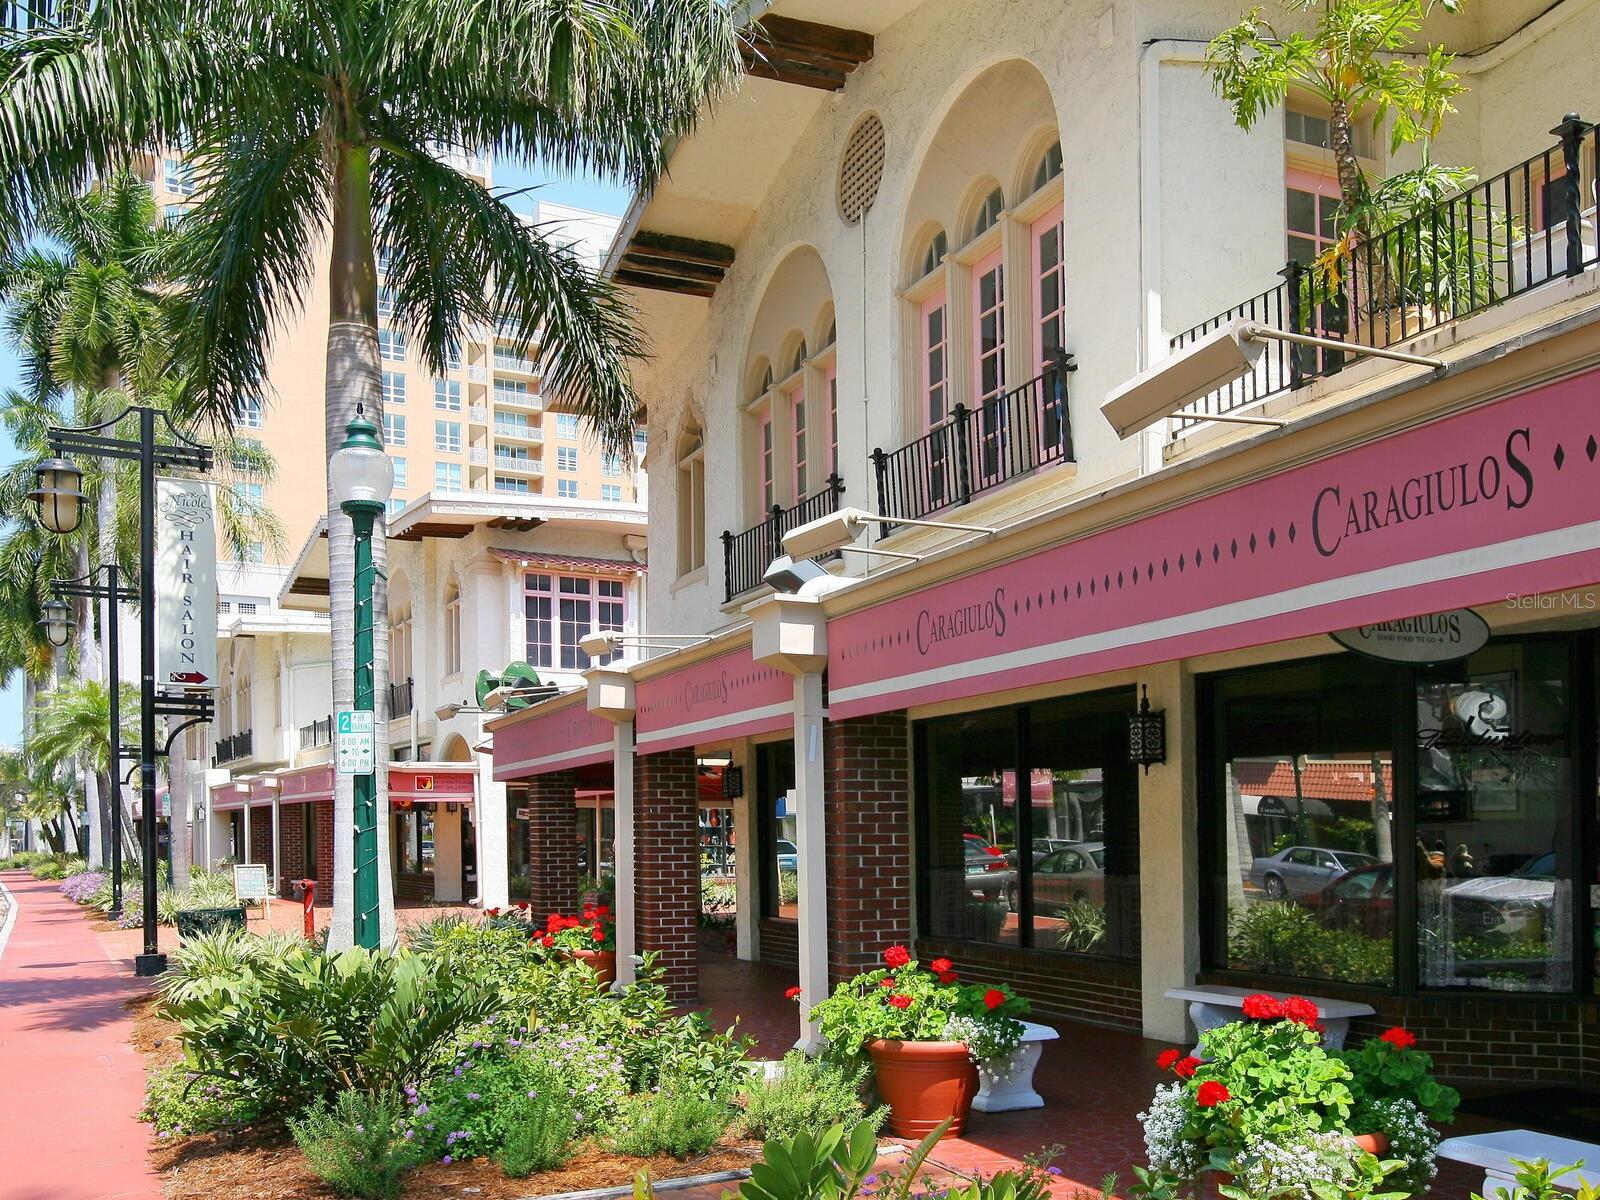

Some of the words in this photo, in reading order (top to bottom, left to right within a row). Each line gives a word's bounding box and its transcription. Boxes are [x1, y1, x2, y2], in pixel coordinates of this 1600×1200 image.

[160, 492, 212, 513] Nicole
[1312, 427, 1534, 557] CARAGIULOS
[180, 530, 194, 584] HAIR
[180, 595, 195, 664] SALON
[916, 587, 1006, 656] CARAGIULOS
[341, 715, 350, 731] 2
[352, 748, 360, 756] TO
[360, 759, 370, 767] PM
